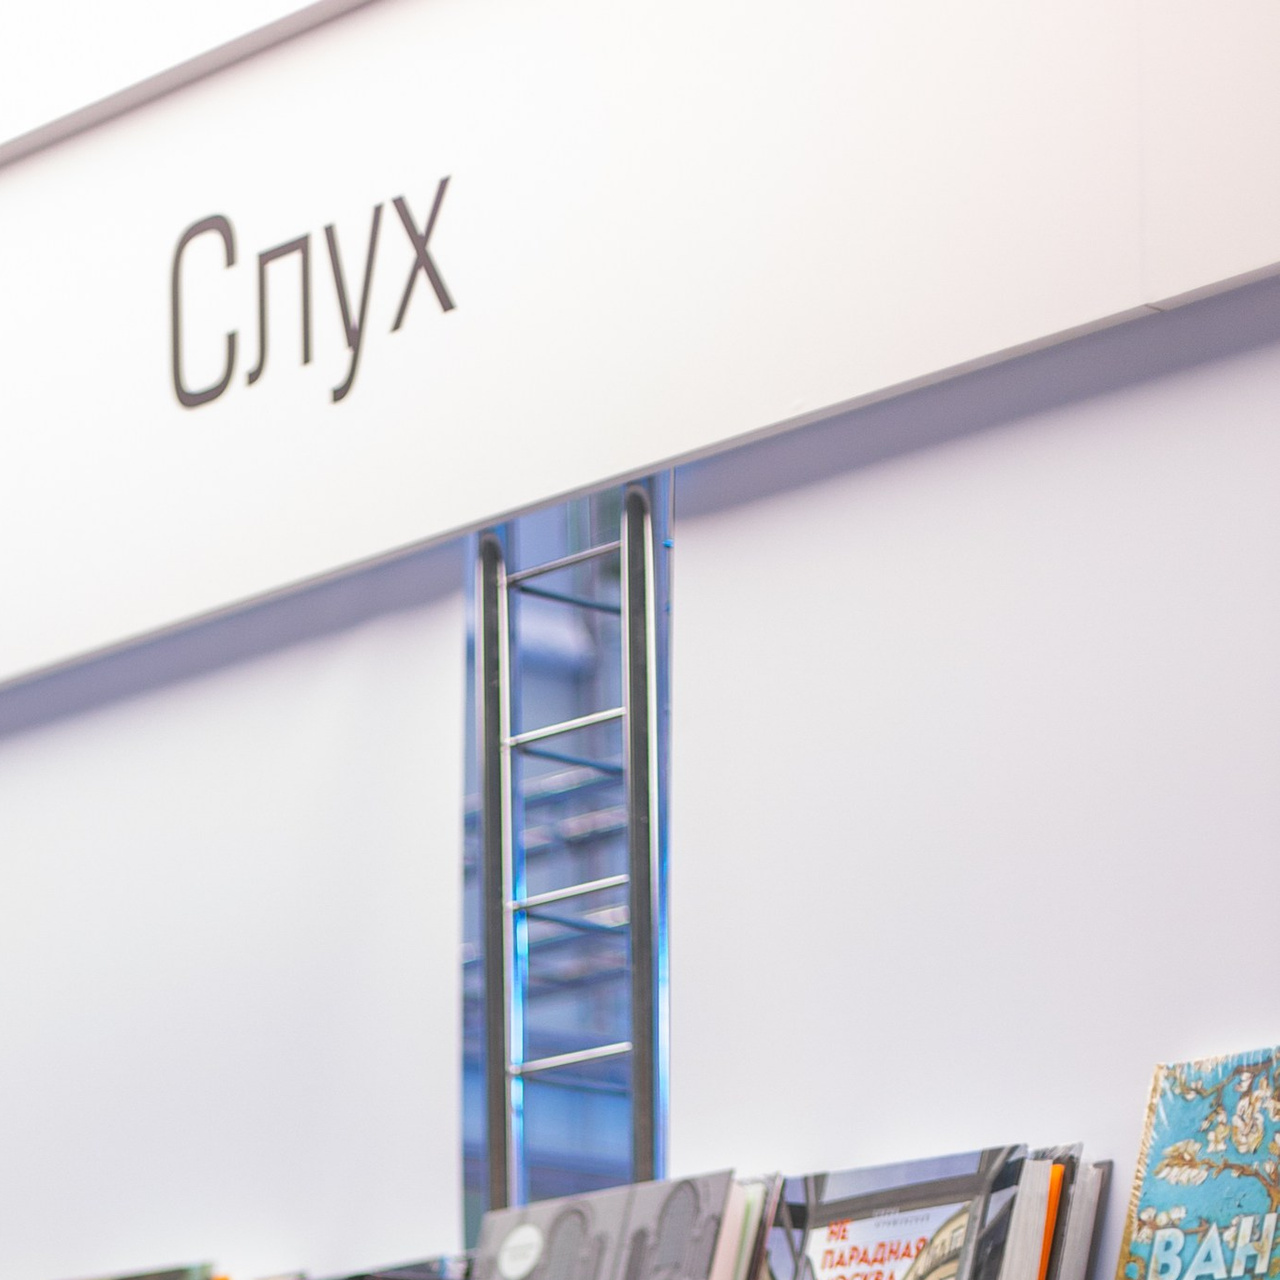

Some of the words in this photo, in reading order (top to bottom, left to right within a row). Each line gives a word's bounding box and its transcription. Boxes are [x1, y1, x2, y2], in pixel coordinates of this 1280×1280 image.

[170, 175, 455, 408] Слух
[827, 1218, 852, 1241] НЕ
[821, 1236, 929, 1269] ПАРАДНАЯ
